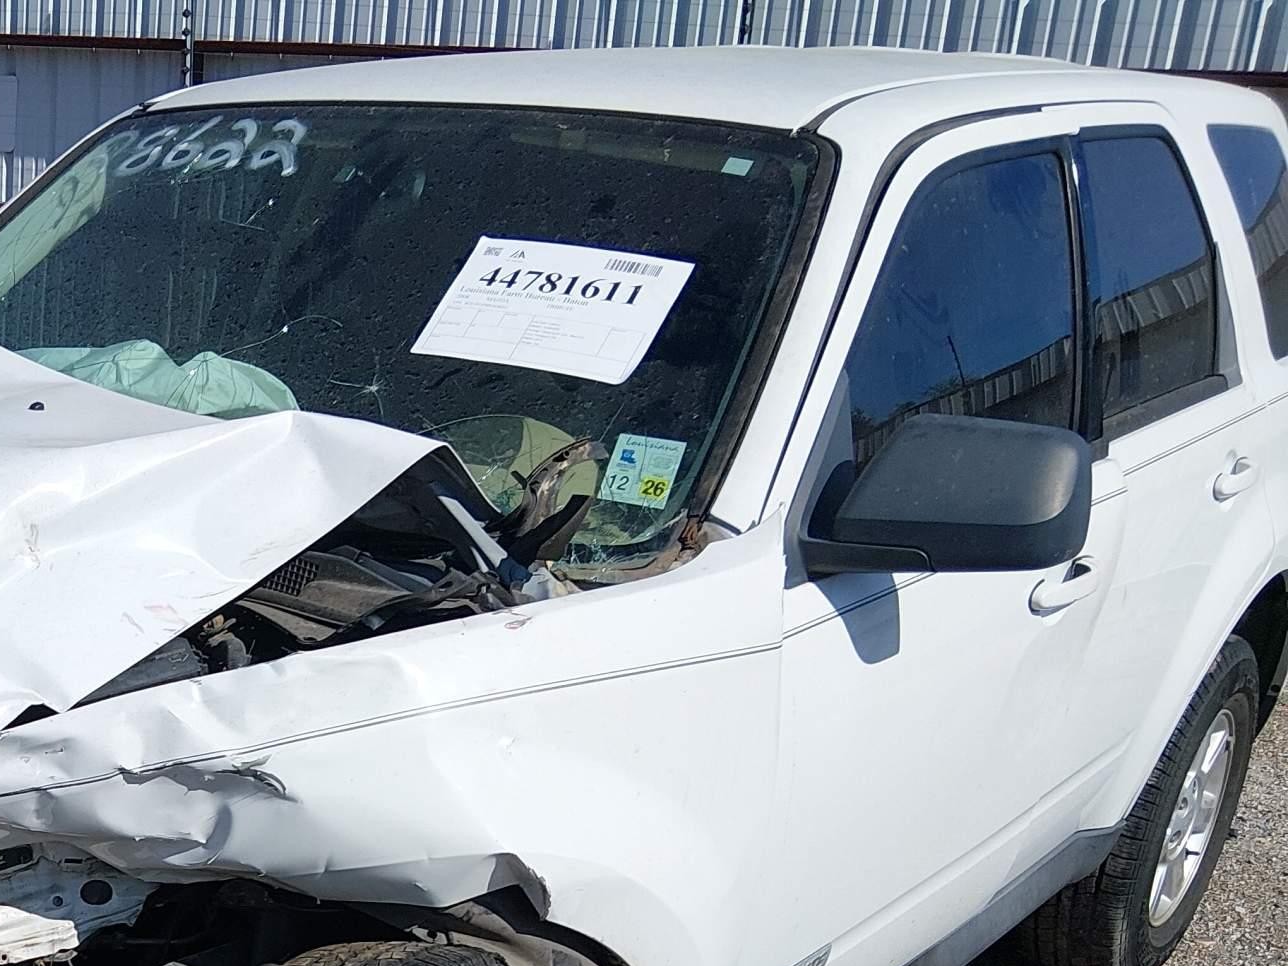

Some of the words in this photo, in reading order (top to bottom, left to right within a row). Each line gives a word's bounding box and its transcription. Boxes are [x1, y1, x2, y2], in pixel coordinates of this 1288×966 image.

[460, 285, 500, 297] Louisiana
[479, 266, 644, 306] 44781611
[625, 436, 680, 452] Louisiana
[608, 473, 630, 491] 12
[641, 479, 667, 497] 26
